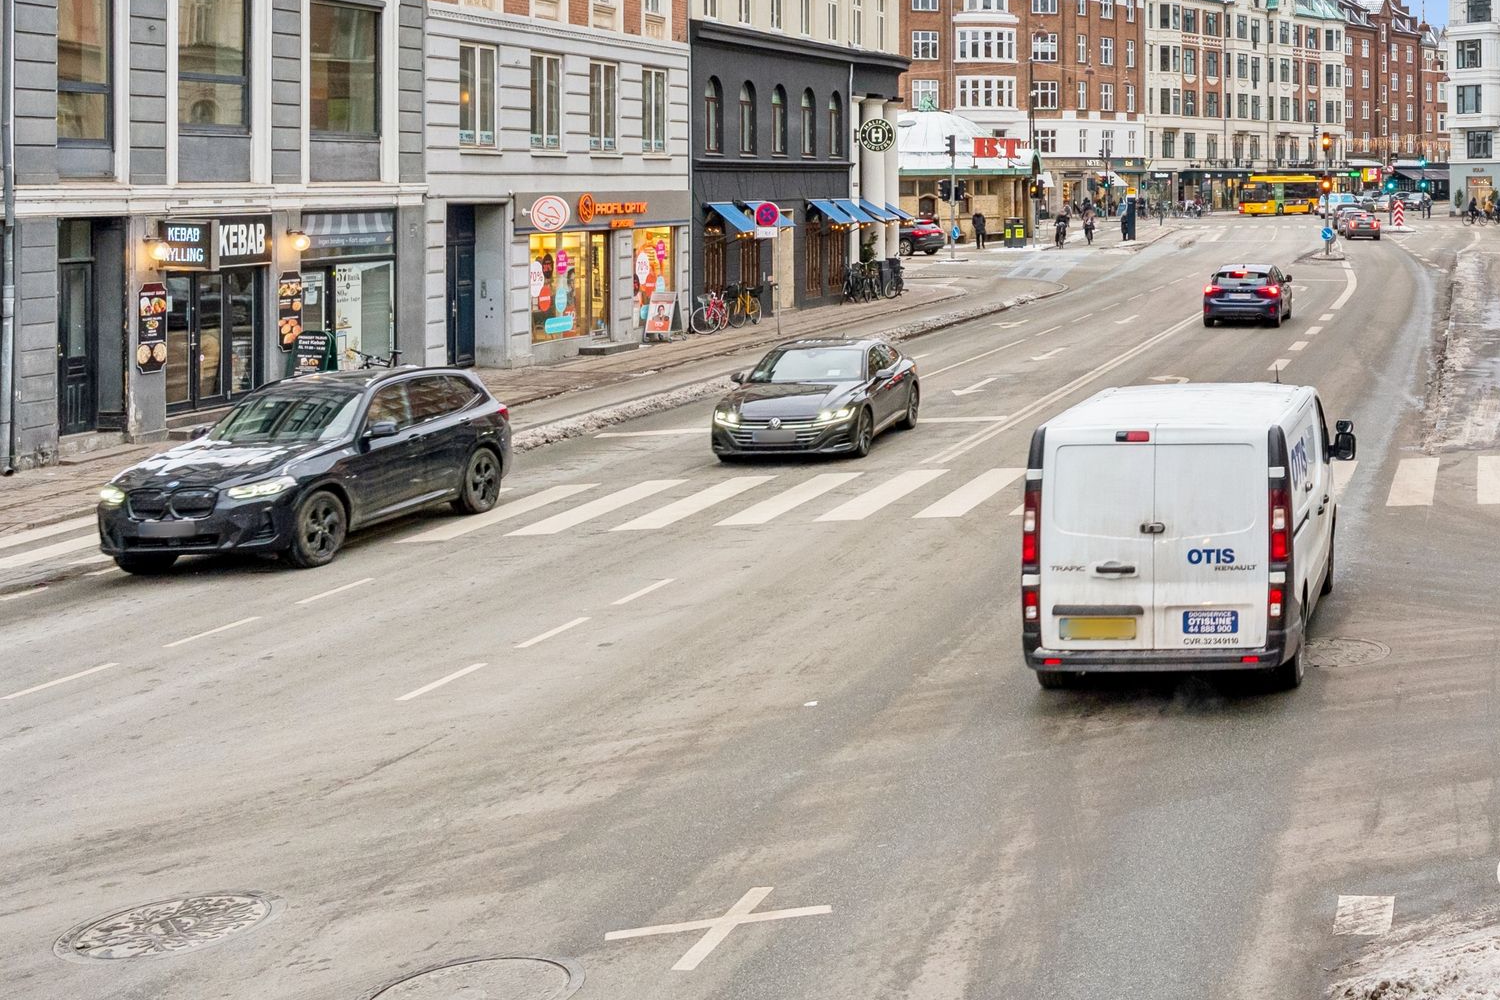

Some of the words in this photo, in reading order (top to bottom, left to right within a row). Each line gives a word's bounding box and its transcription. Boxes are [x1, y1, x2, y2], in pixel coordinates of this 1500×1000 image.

[864, 118, 891, 130] HALIFAX
[871, 128, 883, 143] H
[863, 139, 891, 151] BURGERS
[168, 227, 200, 242] KEBAB
[219, 223, 266, 257] KEBAB
[1291, 436, 1307, 491] OTIS
[1187, 548, 1235, 565] OTIS
[1188, 625, 1199, 633] 44
[1217, 625, 1232, 633] 900
